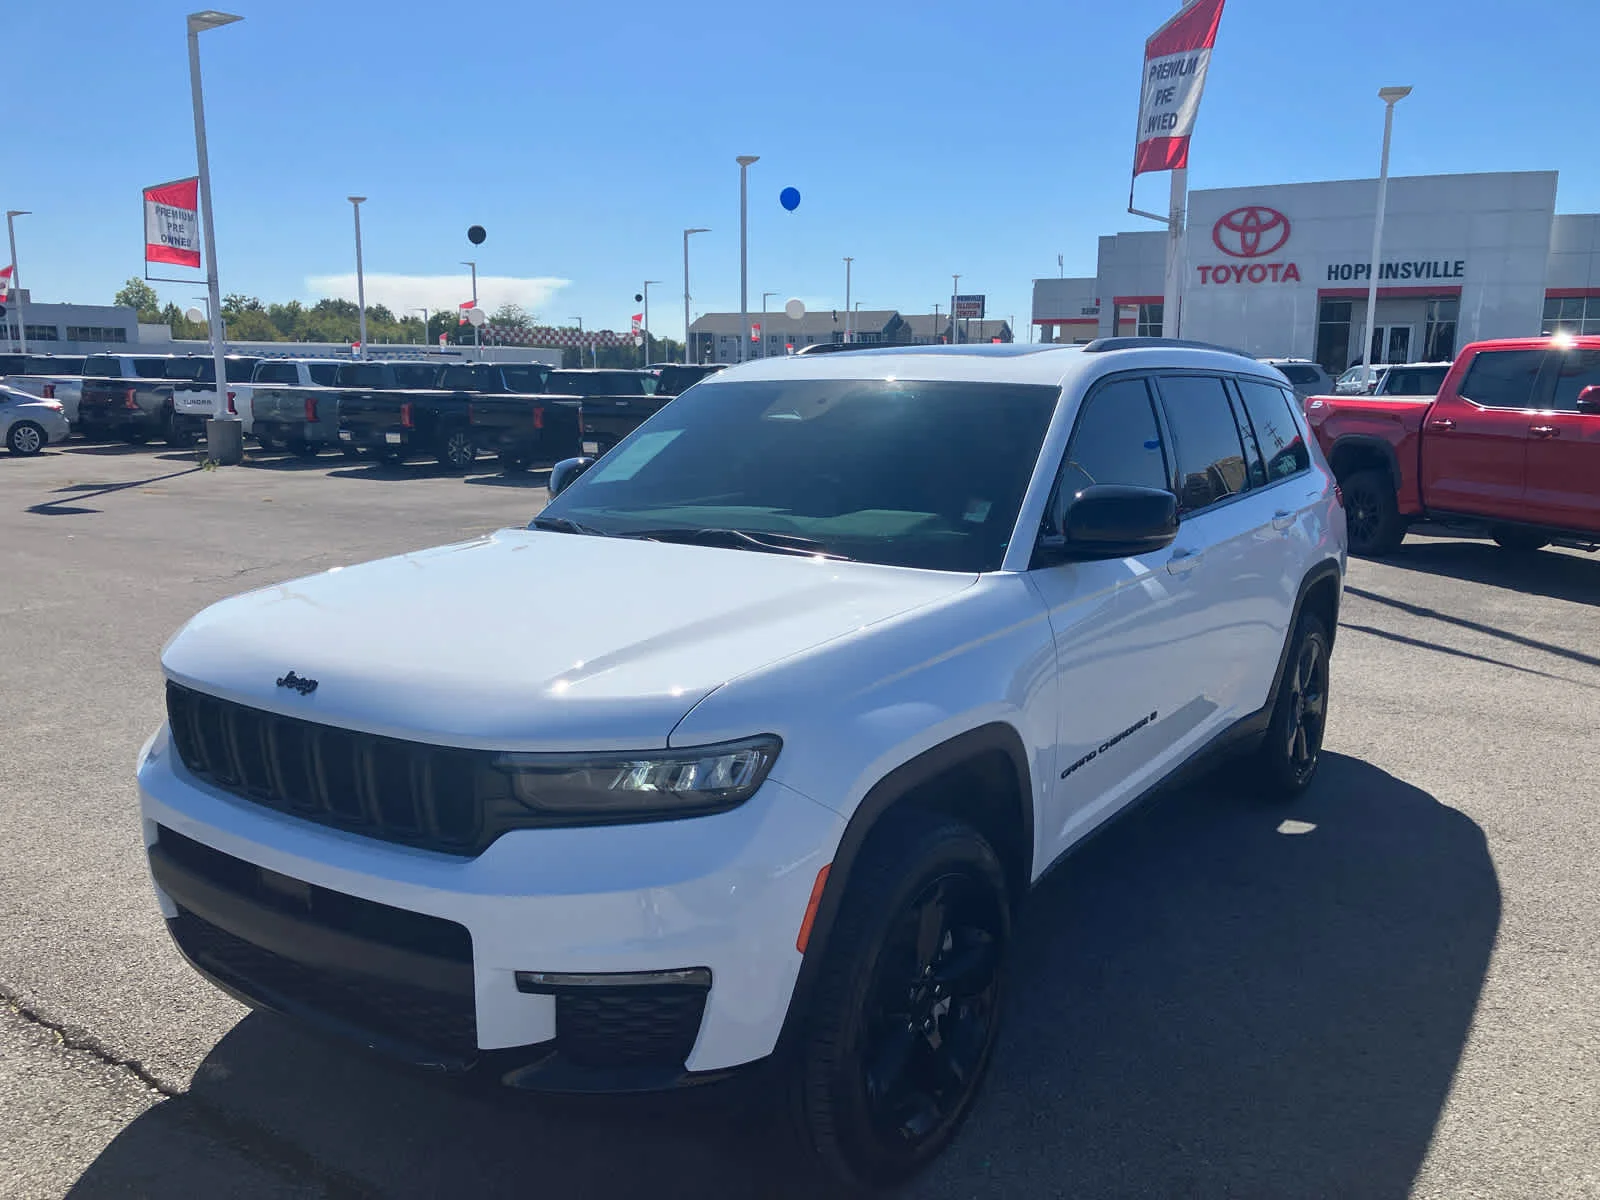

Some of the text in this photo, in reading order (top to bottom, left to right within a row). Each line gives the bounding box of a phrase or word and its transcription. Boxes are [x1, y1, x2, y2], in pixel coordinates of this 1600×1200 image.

[1155, 86, 1176, 106] PRE
[155, 205, 195, 222] PREMIUM
[167, 222, 185, 233] PRE
[160, 234, 192, 248] OWNED
[1197, 262, 1302, 285] TOYOTA
[275, 670, 319, 697] Jeep
[1060, 716, 1149, 780] GRAND CHEROKEE
